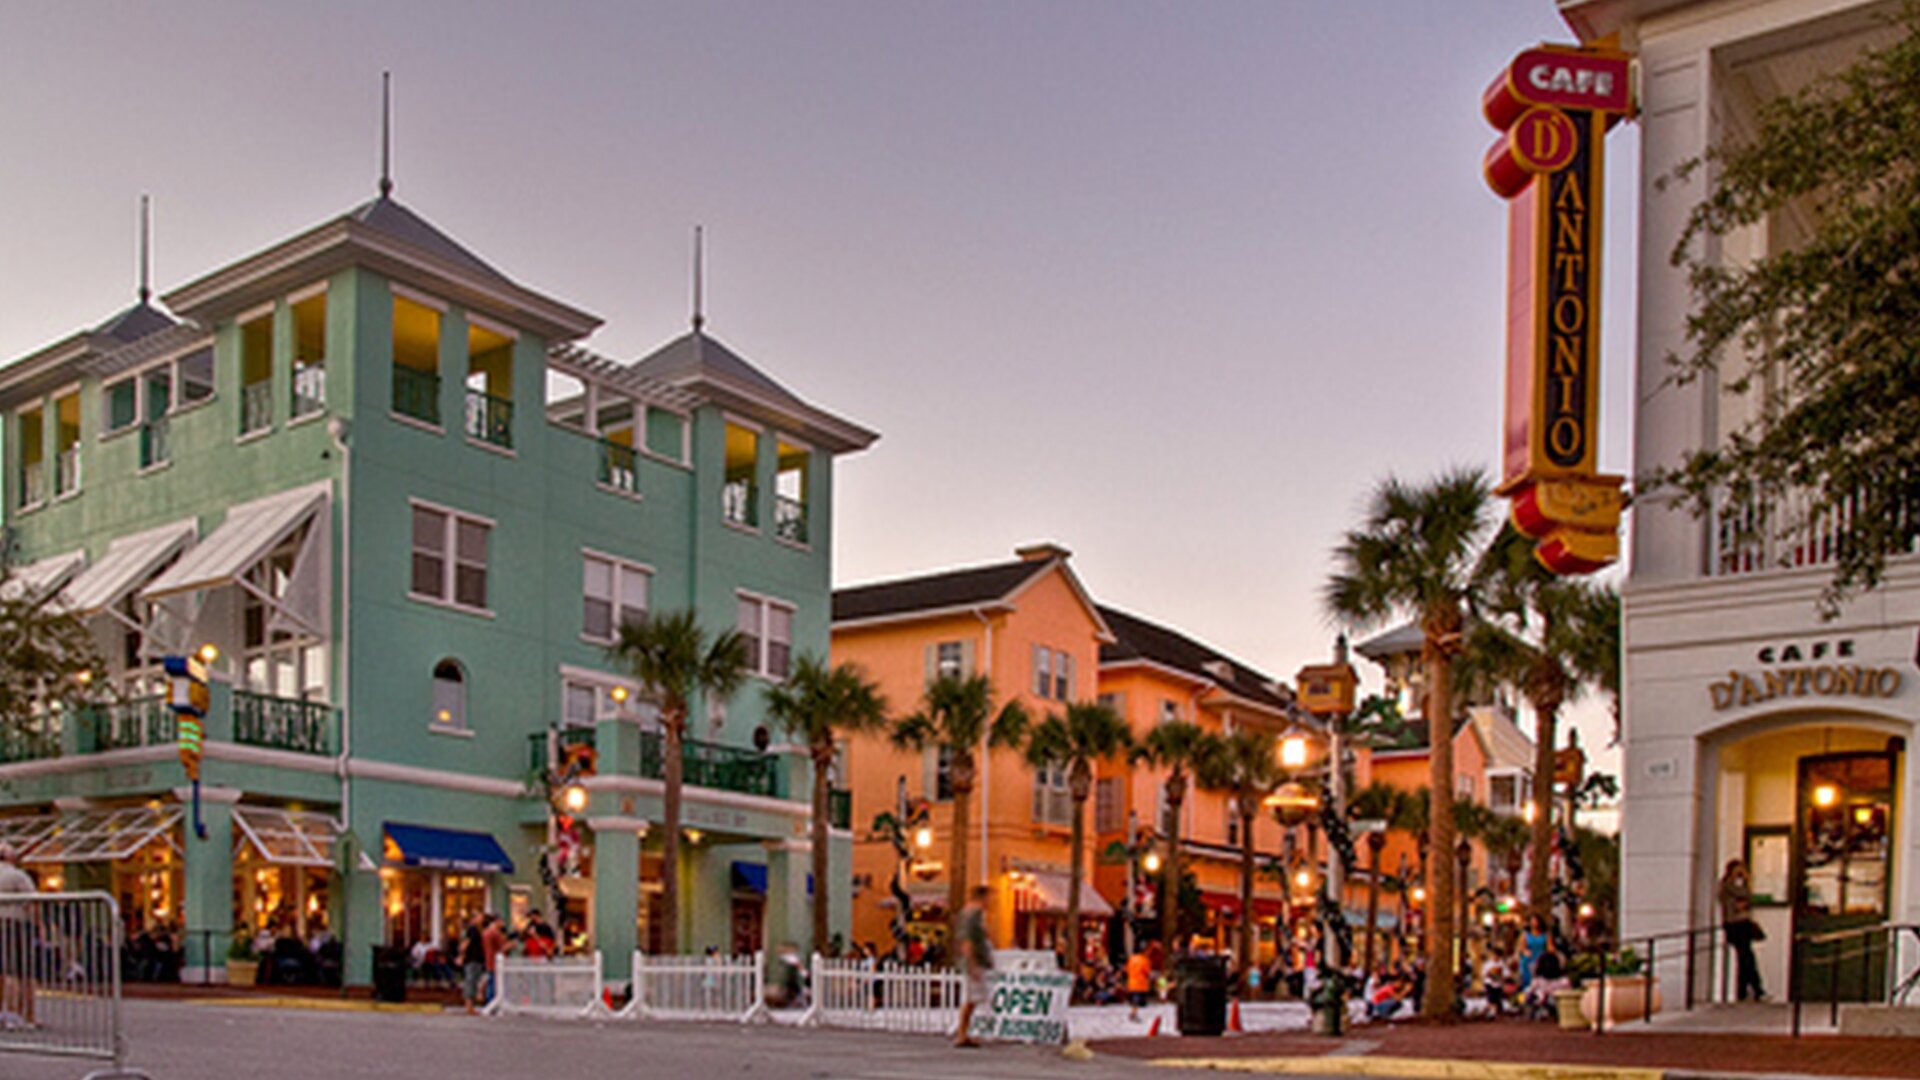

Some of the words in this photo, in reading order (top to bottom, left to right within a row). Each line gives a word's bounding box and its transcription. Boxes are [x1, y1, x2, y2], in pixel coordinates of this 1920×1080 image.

[1529, 64, 1614, 96] CAFE
[1757, 639, 1854, 663] CAFE
[1708, 664, 1901, 710] D'ANTONIO
[992, 987, 1052, 1015] OPEN
